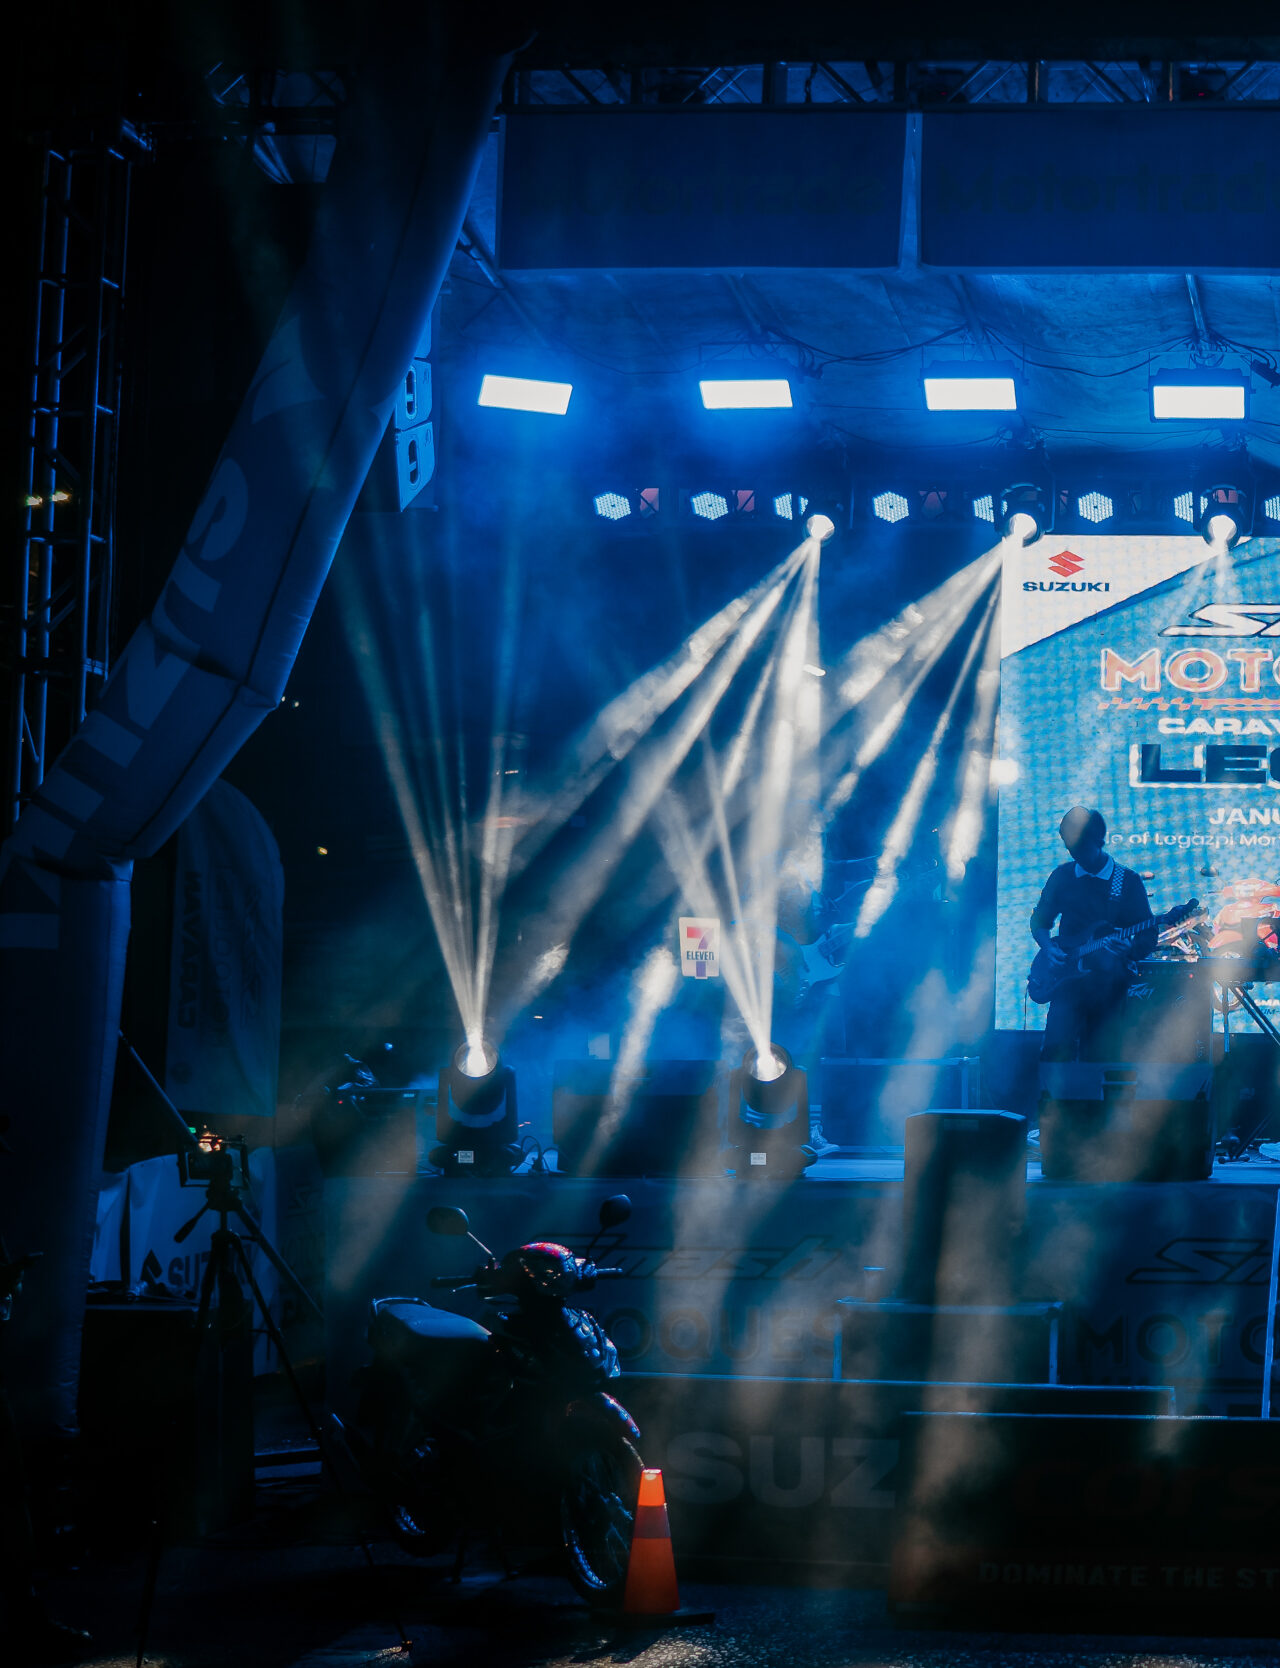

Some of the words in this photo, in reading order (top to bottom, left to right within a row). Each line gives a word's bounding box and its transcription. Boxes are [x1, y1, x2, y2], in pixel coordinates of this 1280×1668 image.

[1022, 581, 1110, 592] SUZUKI
[1129, 830, 1149, 845] of
[1154, 831, 1234, 849] Legazpi
[667, 1431, 899, 1508] SUZ
[977, 1561, 1150, 1587] DOMINATE
[1159, 1564, 1225, 1590] THE
